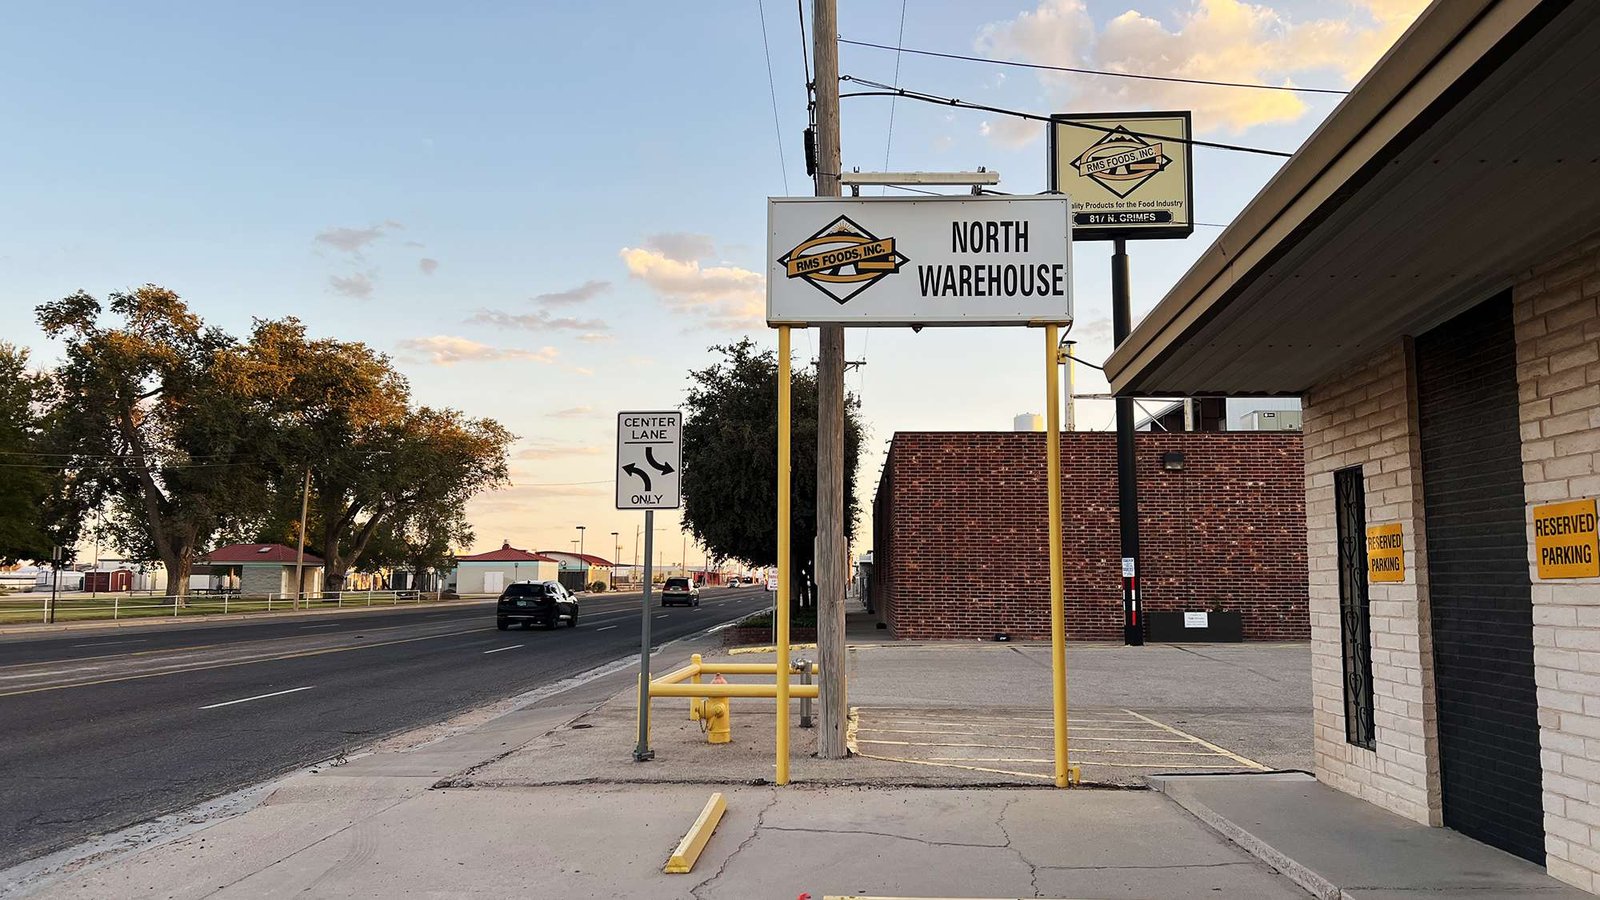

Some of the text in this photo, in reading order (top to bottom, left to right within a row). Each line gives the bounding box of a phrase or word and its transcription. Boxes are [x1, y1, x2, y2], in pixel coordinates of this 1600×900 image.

[1086, 162, 1107, 173] RMS
[1139, 147, 1157, 158] INC.
[1085, 201, 1115, 209] Products
[1126, 200, 1136, 208] the
[1138, 200, 1155, 208] Food
[1156, 200, 1183, 208] Industry
[1107, 214, 1118, 223] N.
[1119, 212, 1156, 222] GRIMES
[952, 220, 1029, 253] NORTH
[796, 243, 885, 272] RMS FOODS, INC.
[917, 263, 1065, 297] WAREHOUSE
[624, 417, 676, 427] CENTER
[631, 429, 668, 440] LANE
[631, 494, 663, 505] ONLY
[1535, 513, 1595, 537] RESERVED
[1367, 533, 1402, 551] RESERVED
[1371, 556, 1400, 572] PARKING
[1541, 544, 1592, 566] PARKING
